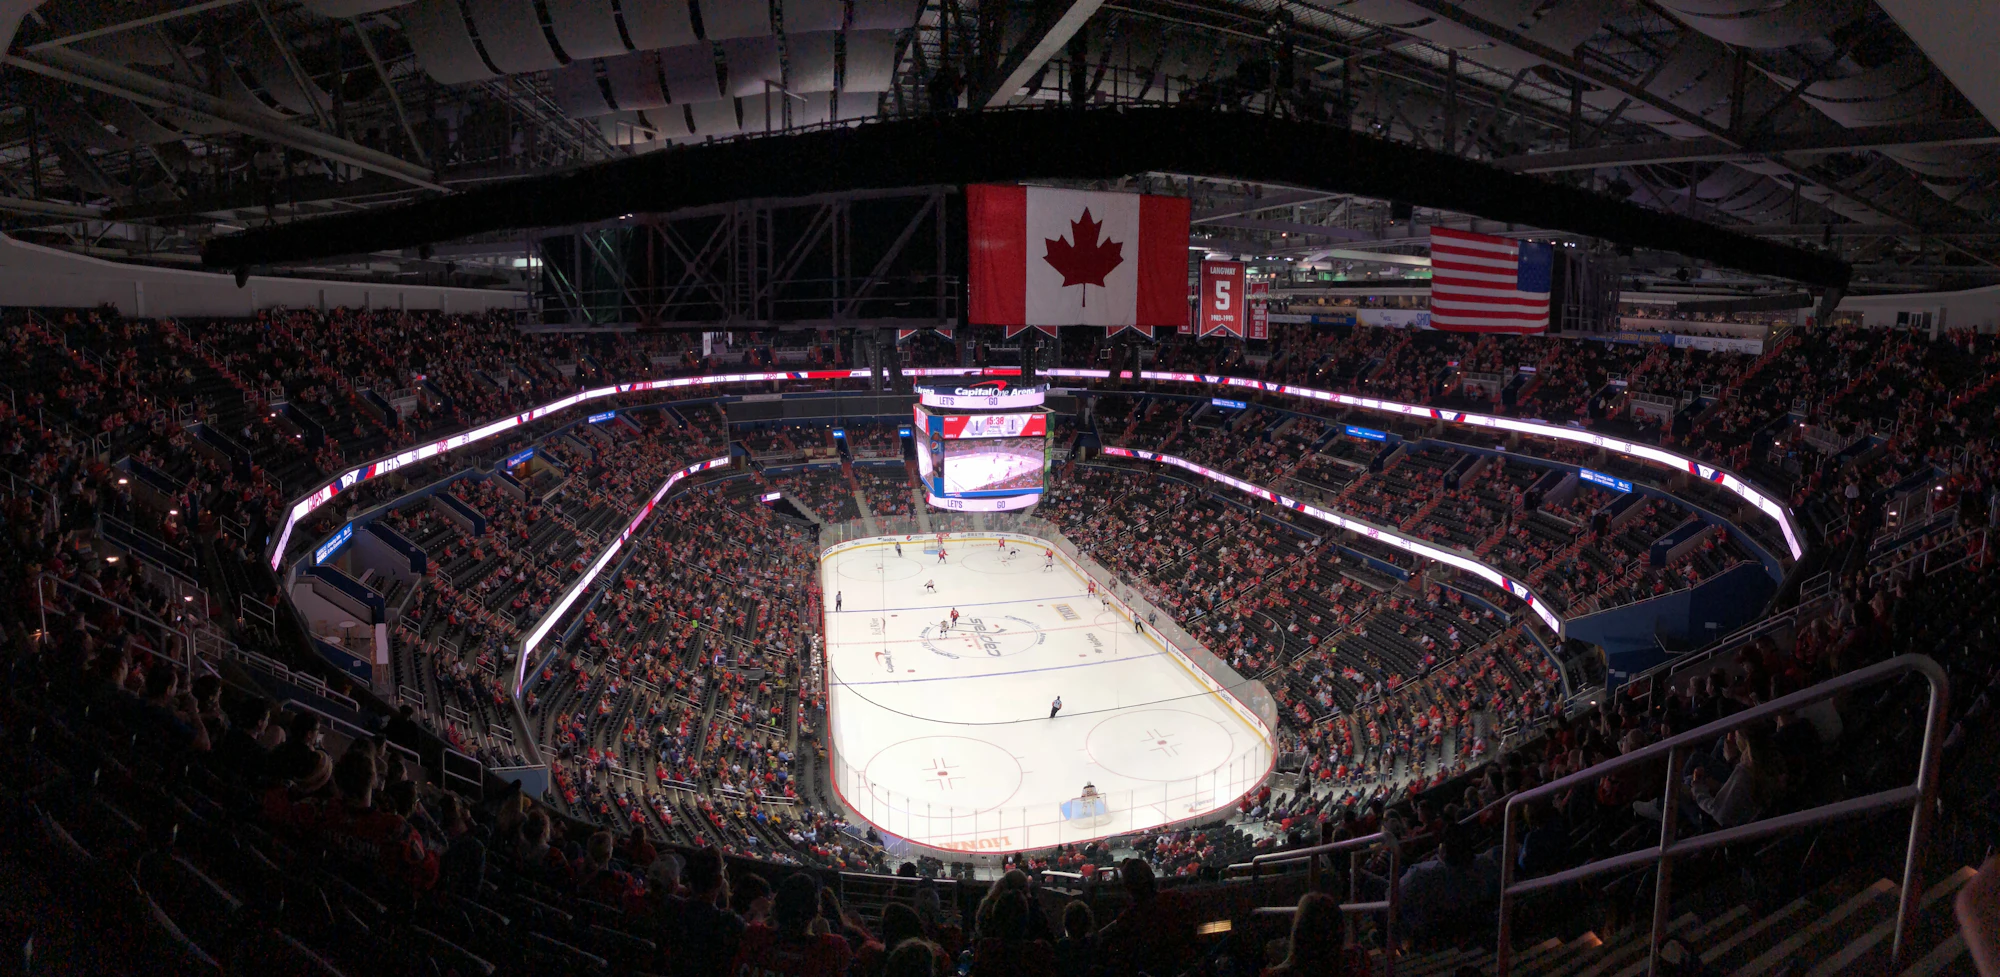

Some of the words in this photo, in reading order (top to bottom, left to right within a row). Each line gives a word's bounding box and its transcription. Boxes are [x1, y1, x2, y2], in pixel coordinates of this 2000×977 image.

[1209, 266, 1236, 275] LANGWAY
[1215, 280, 1230, 310] 5
[918, 387, 935, 396] Arena
[1010, 387, 1036, 396] Arena
[939, 396, 954, 406] LET'S
[988, 397, 998, 406] GO
[947, 499, 963, 509] LET'S
[997, 500, 1006, 509] GO
